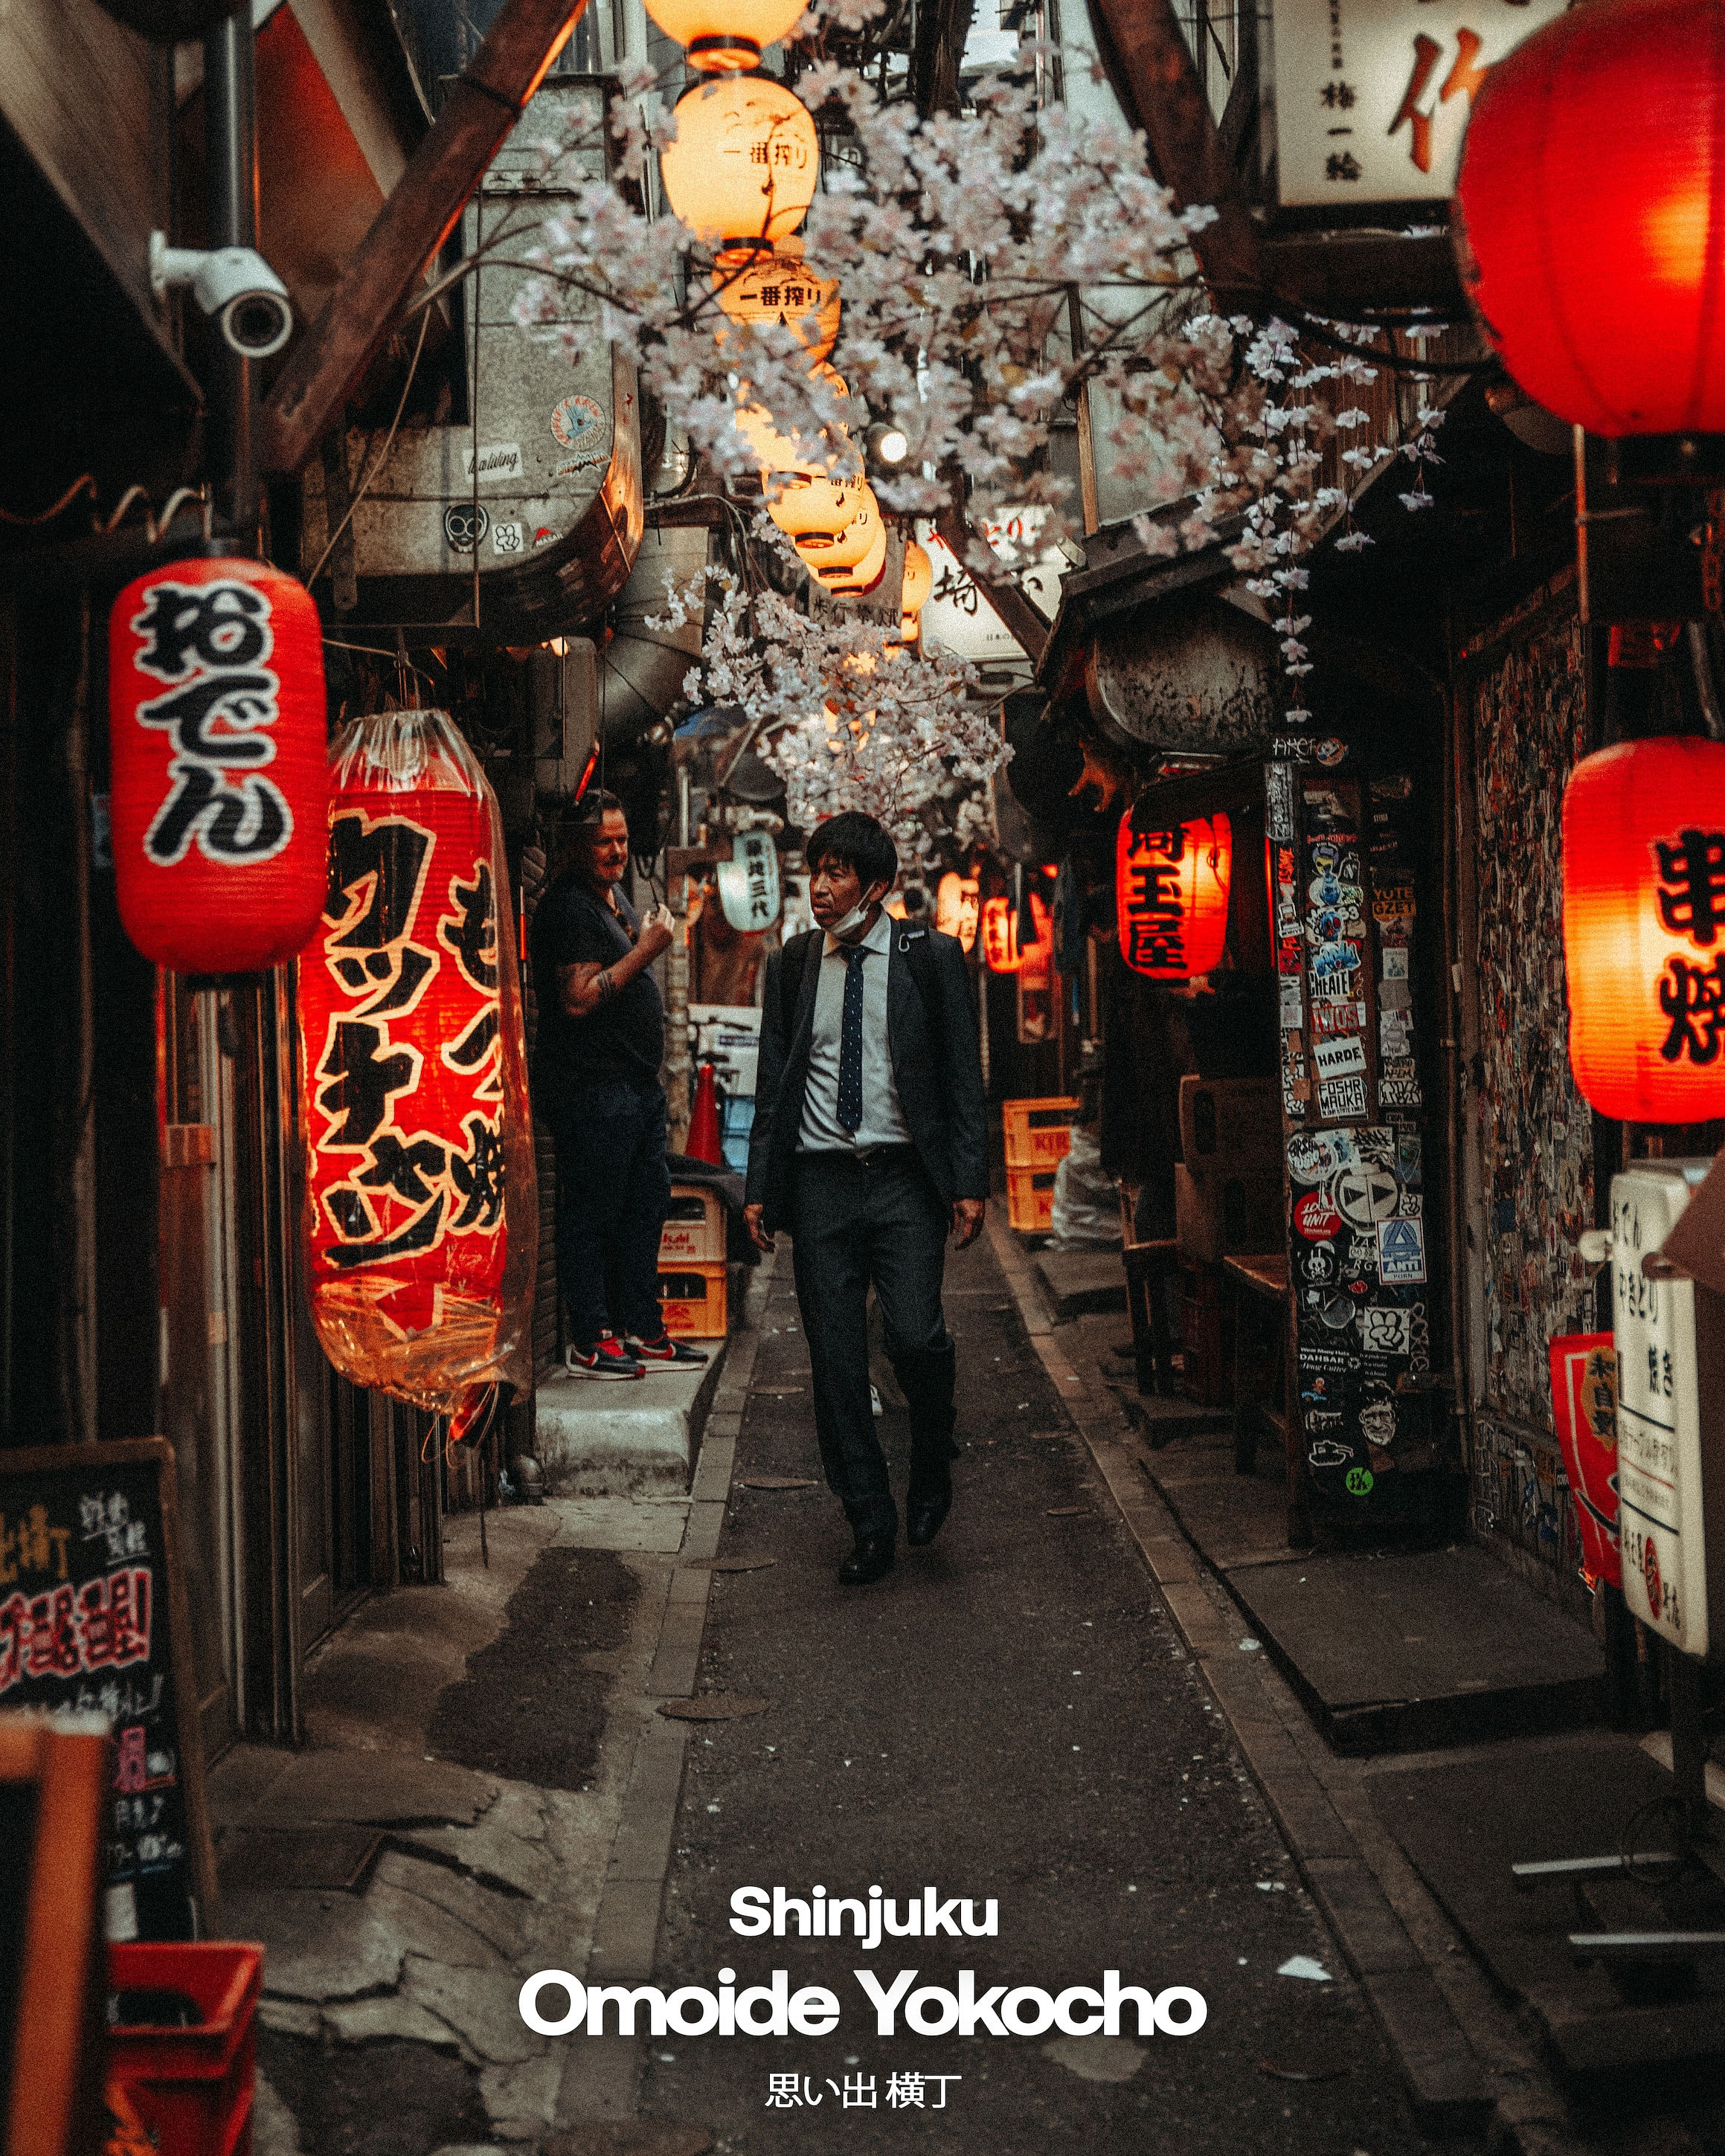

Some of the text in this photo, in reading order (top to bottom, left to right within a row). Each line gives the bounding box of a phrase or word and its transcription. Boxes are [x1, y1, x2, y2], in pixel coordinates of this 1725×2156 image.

[724, 141, 809, 170] 一番搾り
[739, 285, 822, 308] 一番搾り
[132, 579, 294, 866] おでん
[1387, 1259, 1420, 1272] ANTI
